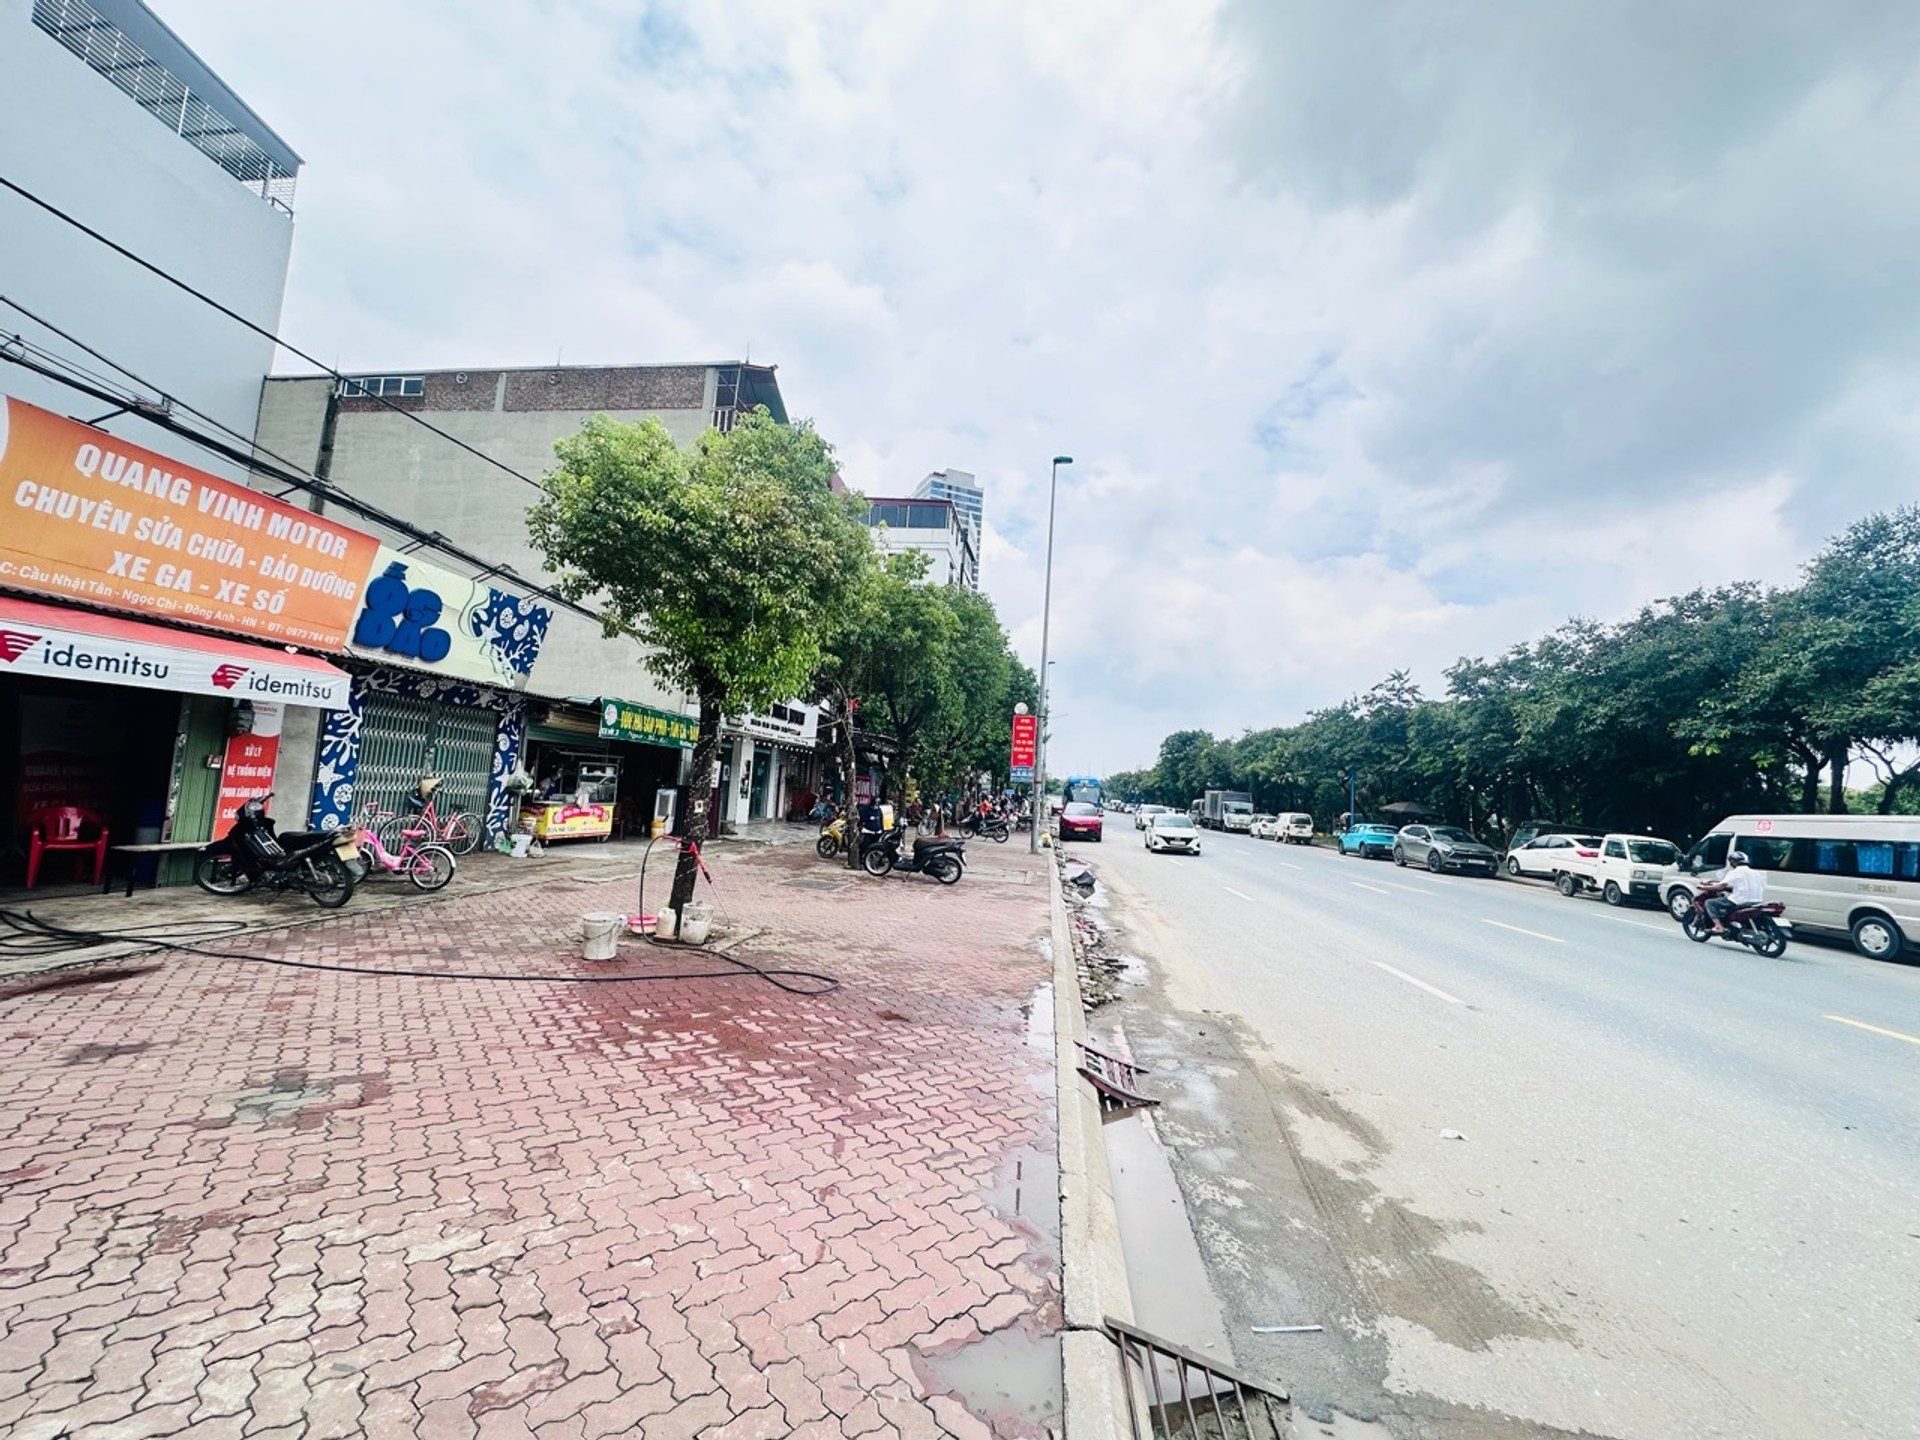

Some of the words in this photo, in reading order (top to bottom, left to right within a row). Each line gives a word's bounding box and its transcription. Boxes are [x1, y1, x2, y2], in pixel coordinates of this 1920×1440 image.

[75, 443, 192, 507] QUANG
[197, 486, 265, 531] VINH
[266, 512, 348, 560] MOTOR
[15, 480, 133, 535] CHUYÊN
[134, 515, 184, 551] SỬA
[187, 533, 245, 569] CHỮA
[259, 554, 298, 584] BẢO
[299, 567, 357, 600] DƯỠNG
[19, 565, 49, 582] Cầu
[52, 572, 86, 590] Nhật
[88, 580, 113, 596] Tân
[122, 589, 155, 605] Ngọc
[214, 609, 236, 623] Anh
[241, 615, 257, 628] HN
[106, 551, 151, 582] XE
[154, 564, 193, 593] GA
[214, 578, 250, 606] XE
[252, 588, 290, 615] SỐ
[43, 640, 169, 679] idemitsu
[248, 671, 332, 700] idemitsu
